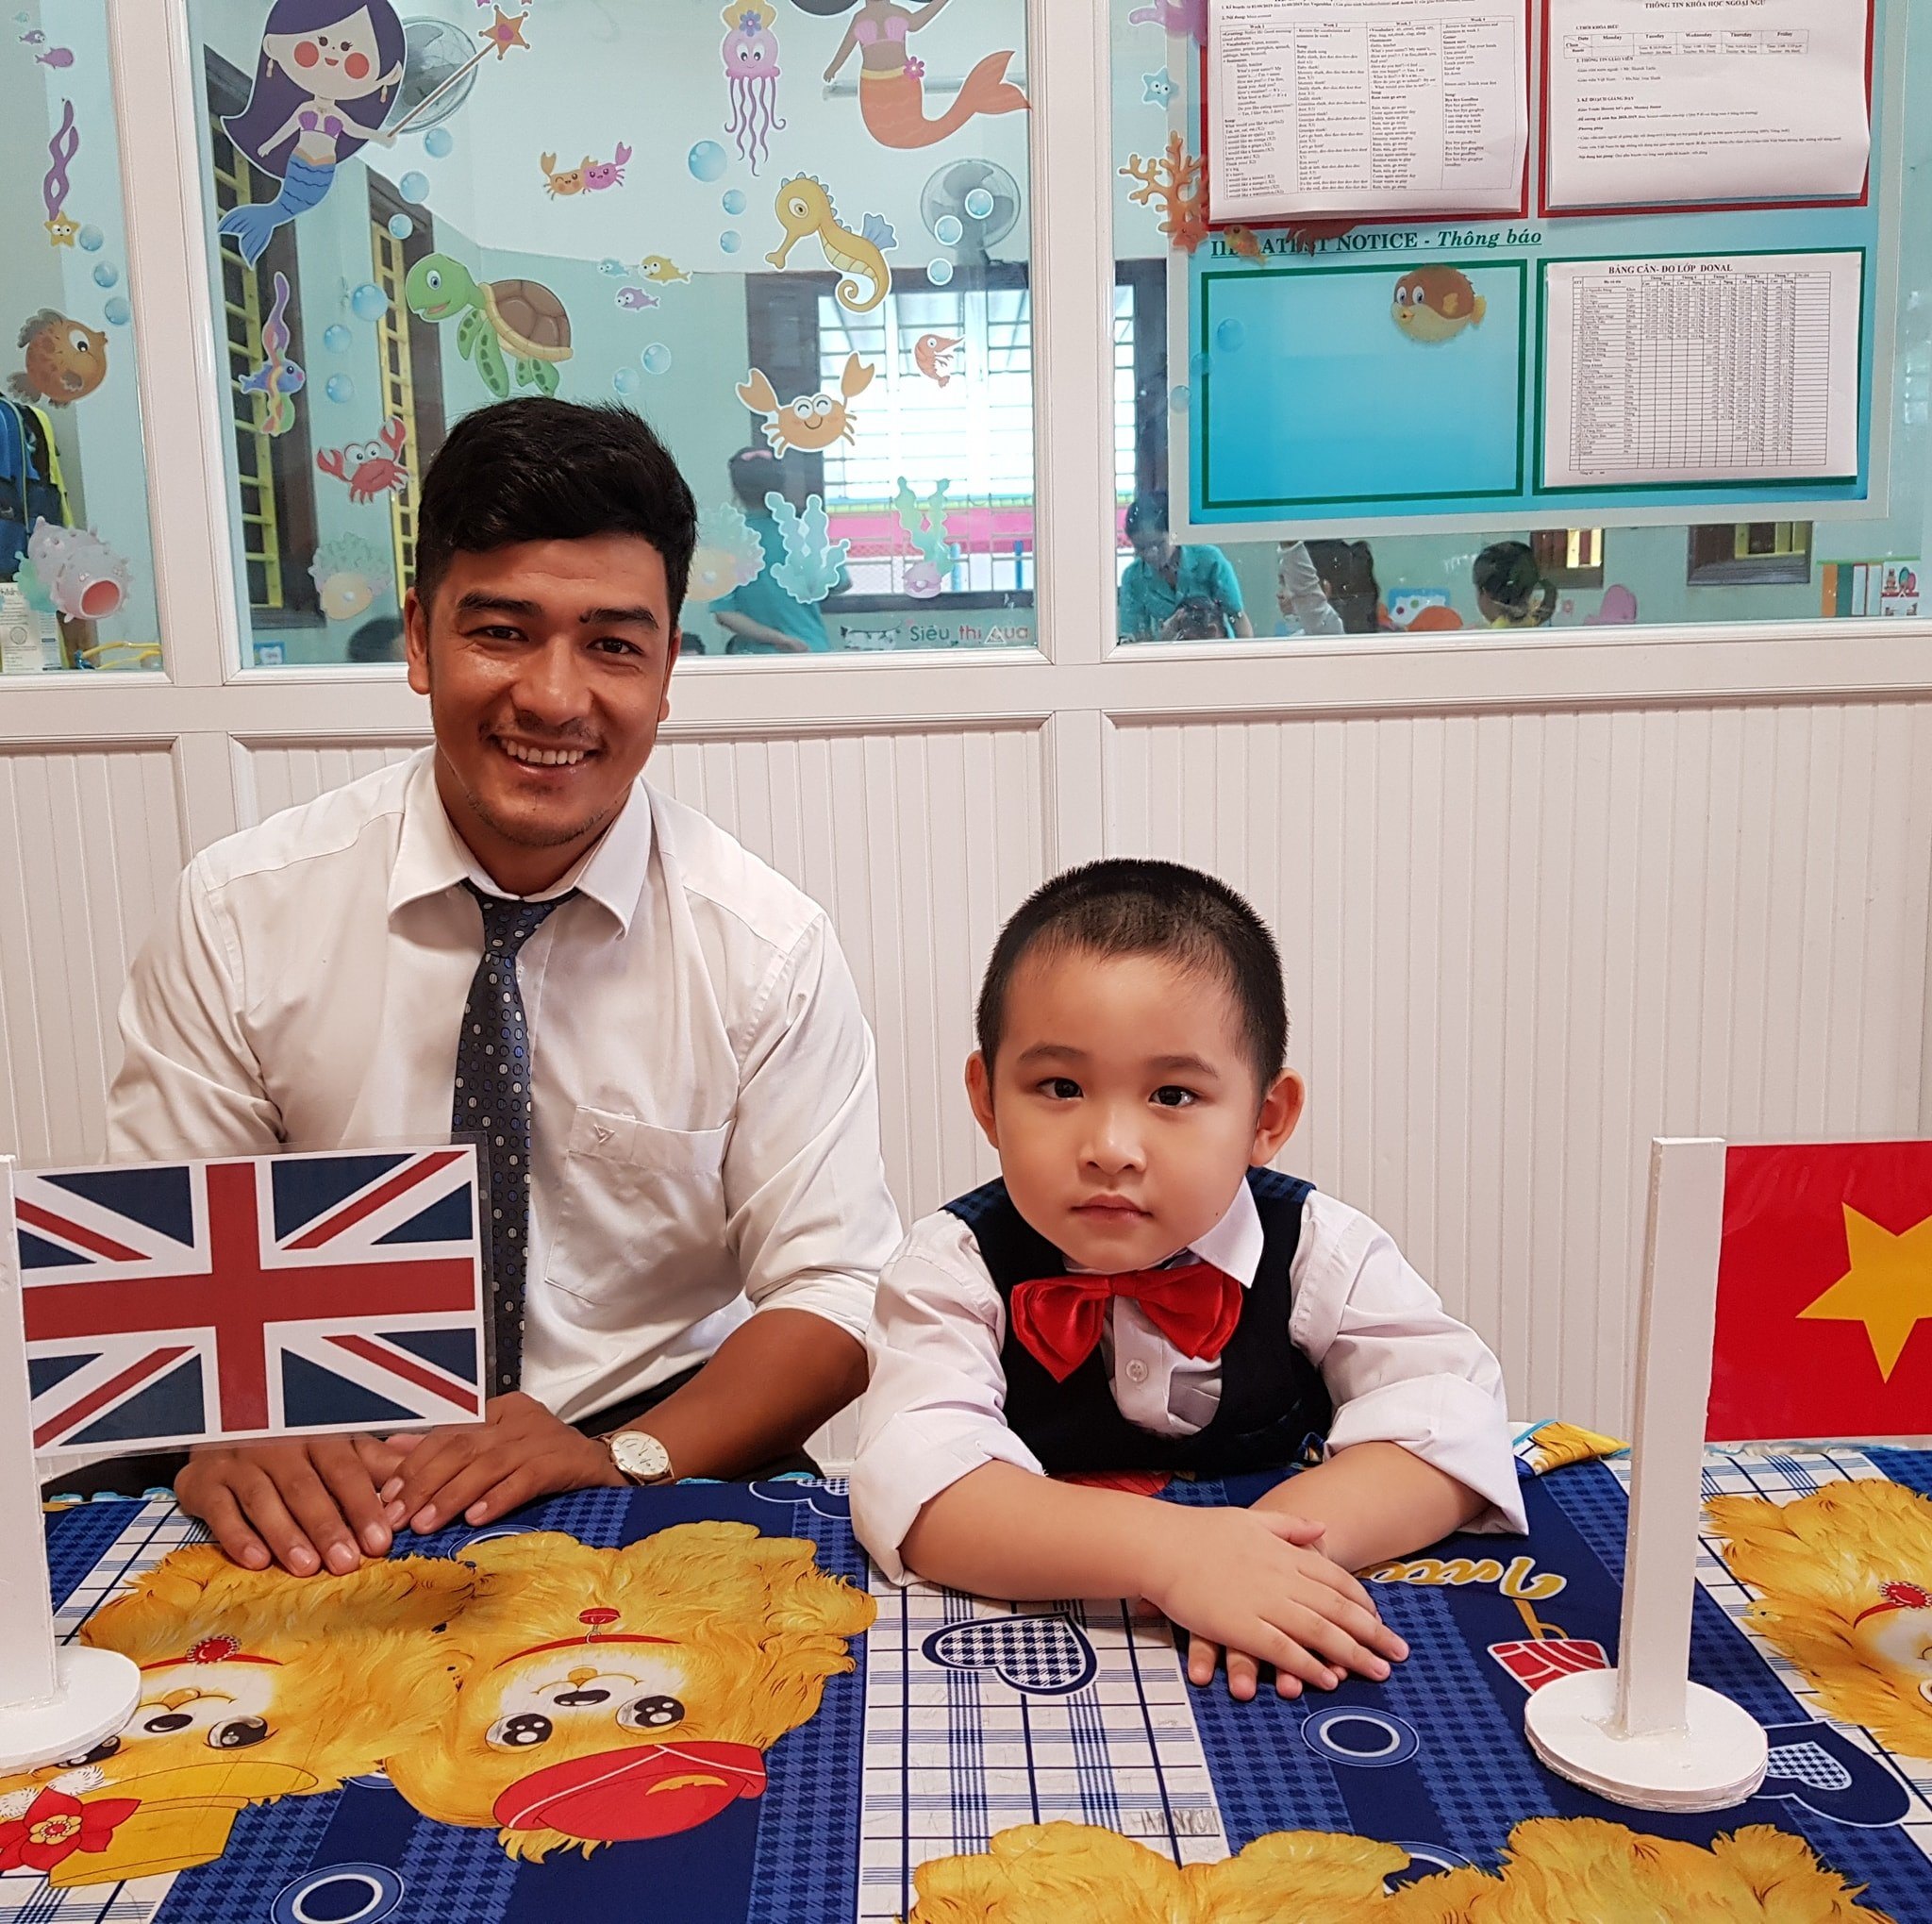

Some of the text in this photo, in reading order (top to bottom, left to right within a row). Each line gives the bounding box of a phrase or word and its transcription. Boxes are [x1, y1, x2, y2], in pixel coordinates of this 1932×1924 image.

[1336, 232, 1417, 251] NOTICE
[1438, 230, 1500, 248] Thông
[1507, 228, 1542, 244] báo
[1609, 264, 1634, 274] BẢNG
[1678, 262, 1696, 272] LỚP
